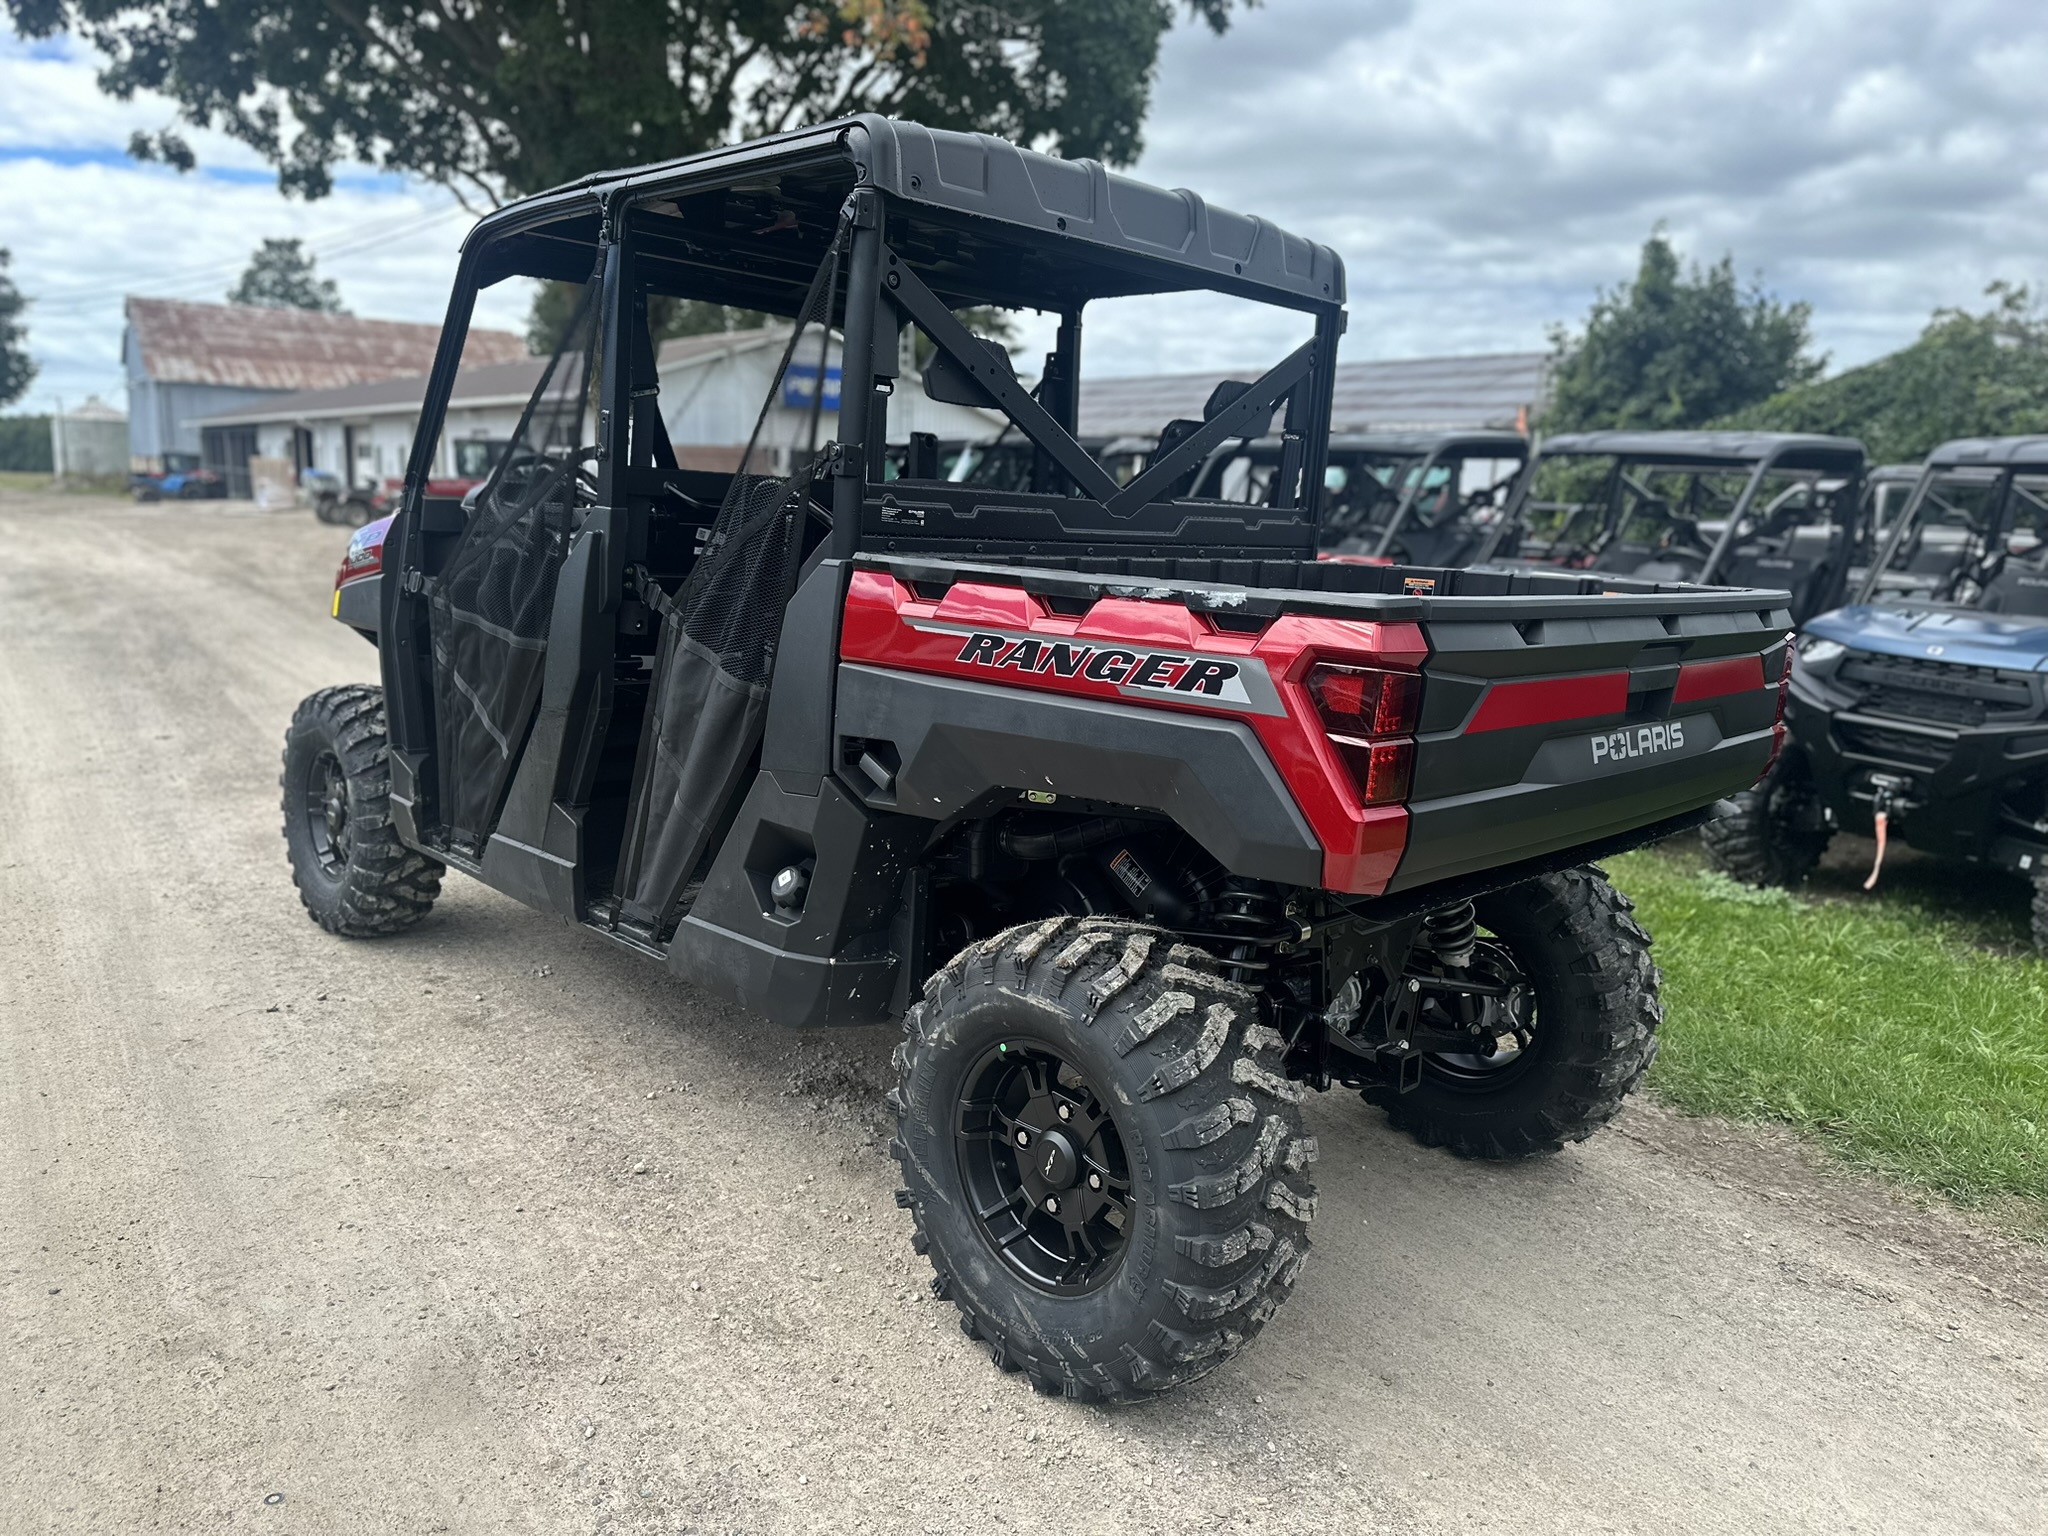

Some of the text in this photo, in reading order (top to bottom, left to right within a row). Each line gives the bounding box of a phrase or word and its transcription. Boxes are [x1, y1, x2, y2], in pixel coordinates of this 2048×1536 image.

[957, 633, 1239, 696] RANGER
[1591, 722, 1684, 764] POLARIS
[1138, 1186, 1156, 1279] ARMOR
